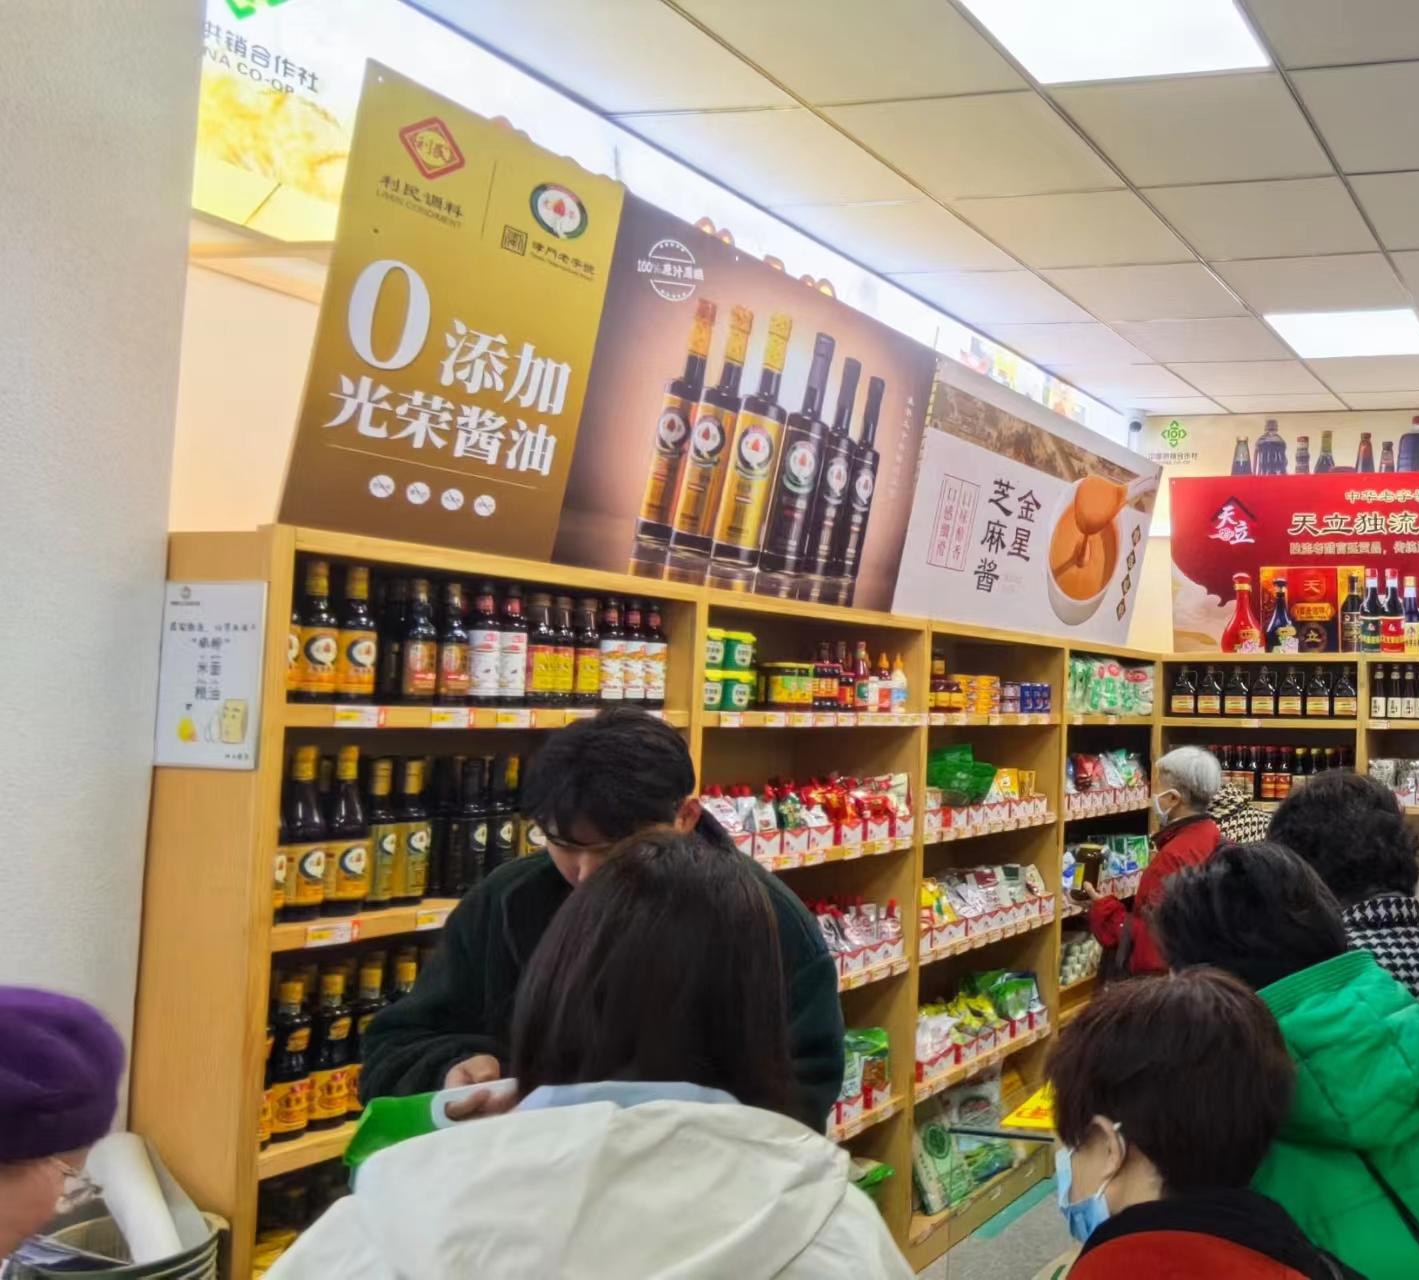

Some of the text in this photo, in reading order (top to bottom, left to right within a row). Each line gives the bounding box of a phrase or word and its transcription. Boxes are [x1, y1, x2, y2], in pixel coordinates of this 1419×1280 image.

[380, 175, 464, 219] 利民调料
[348, 258, 572, 415] 0 添加
[322, 373, 557, 476] 光荣酱油
[973, 478, 1014, 593] 芝麻酱
[1007, 489, 1042, 562] 金星
